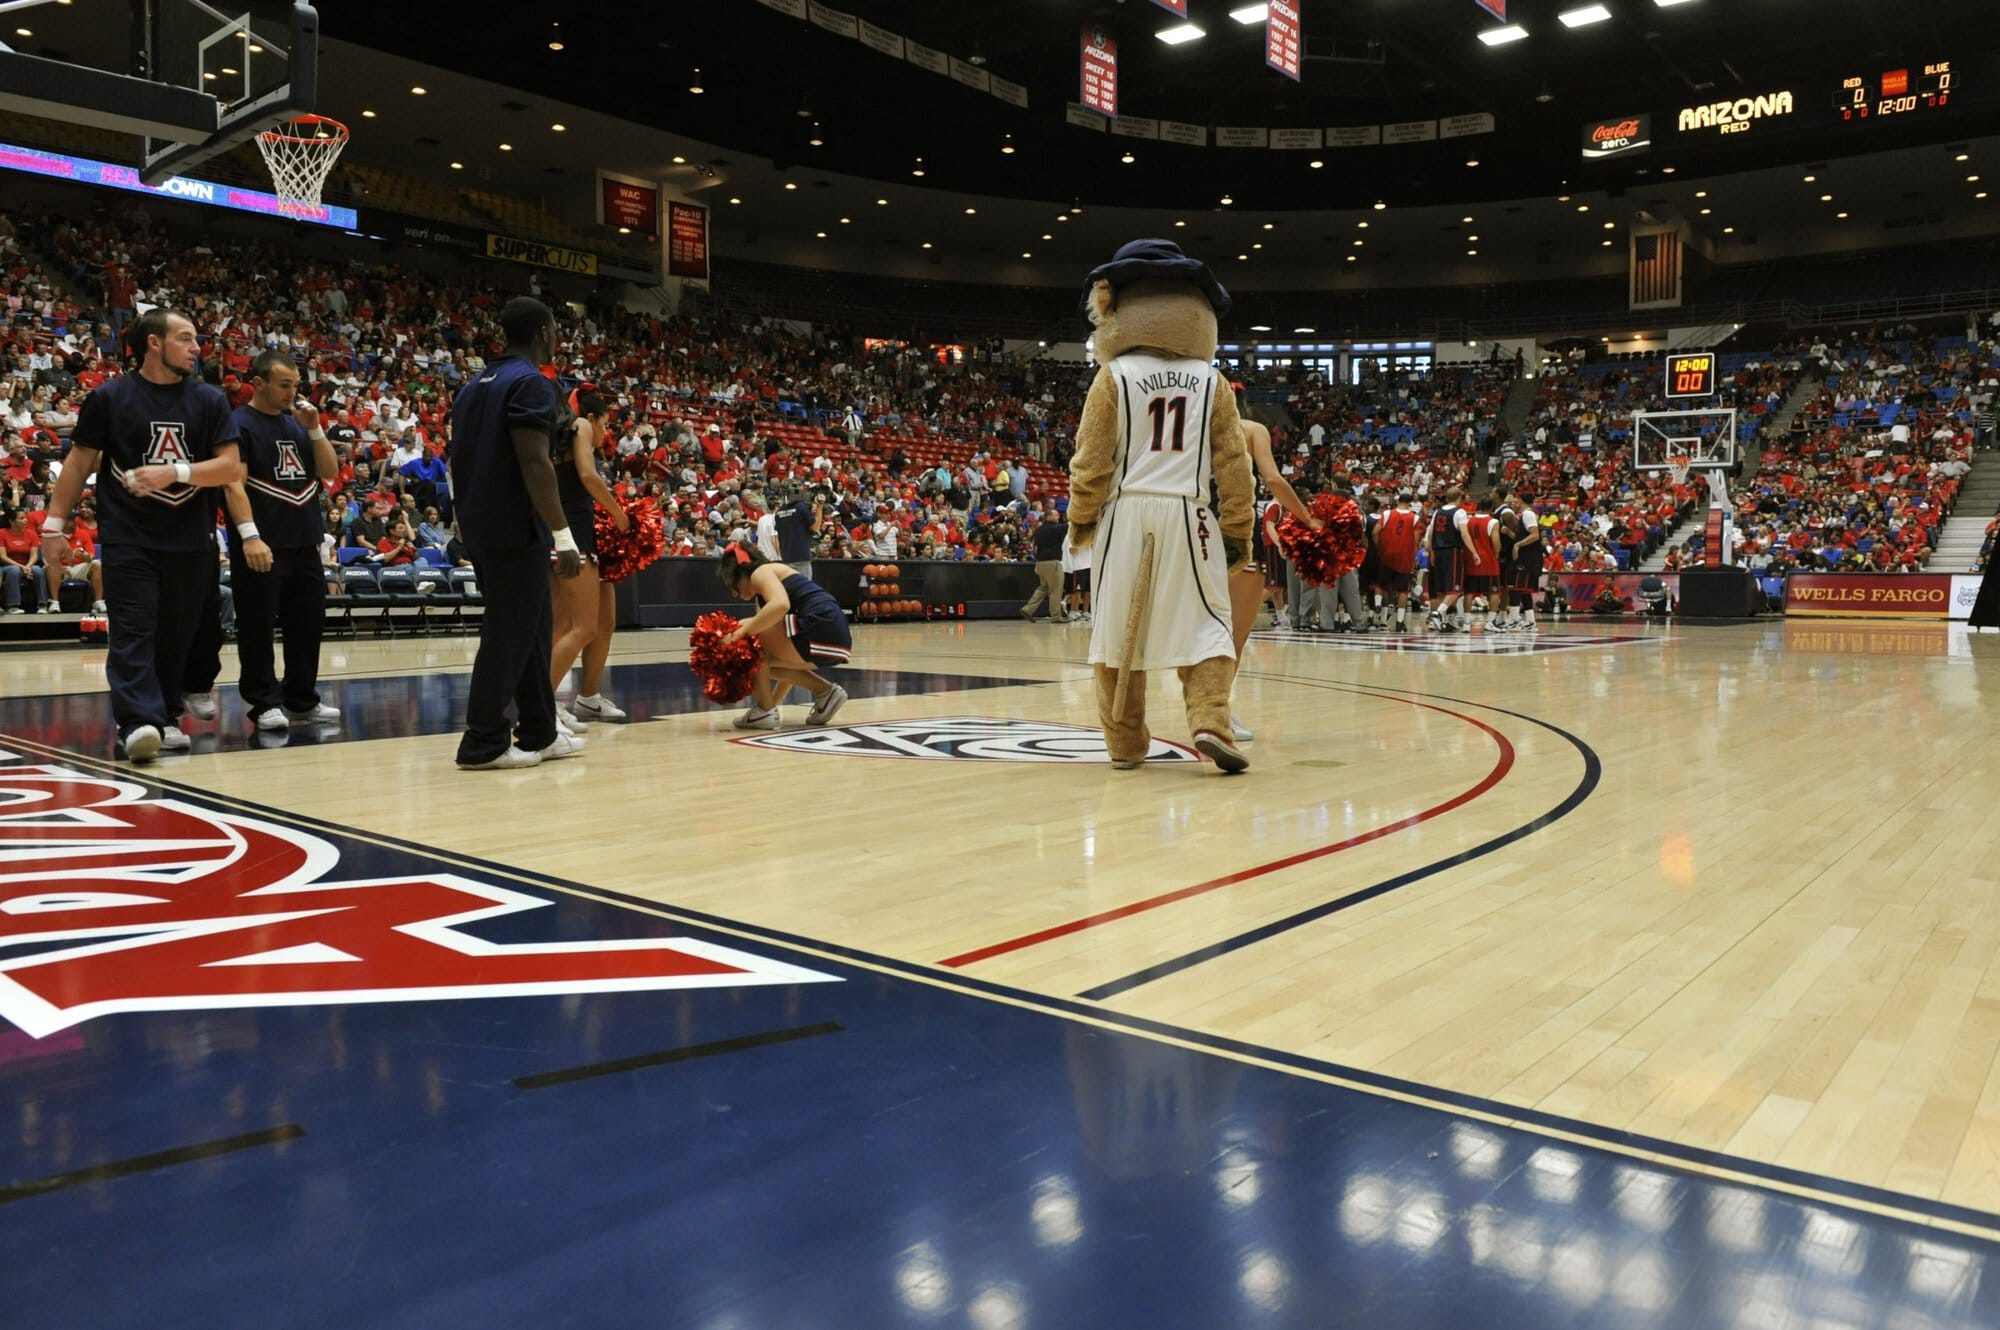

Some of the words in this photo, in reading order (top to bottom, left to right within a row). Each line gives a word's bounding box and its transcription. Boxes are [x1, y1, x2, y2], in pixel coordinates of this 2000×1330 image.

[1085, 45, 1115, 64] ARIZONA
[1924, 61, 1950, 75] BLUE
[1843, 76, 1862, 89] RED
[1939, 73, 1950, 89] 0
[1853, 88, 1865, 103] 0
[1878, 95, 1917, 115] 12:00
[1678, 90, 1793, 132] ARIZONA
[1592, 119, 1641, 143] Coca-Cola
[1720, 120, 1751, 135] RED
[620, 188, 641, 201] WAC
[492, 236, 590, 272] SUPERCUTS
[1675, 358, 1709, 373] 12:00
[1136, 371, 1200, 395] WILBUR
[1676, 373, 1703, 391] 00
[1147, 396, 1187, 452] 11
[142, 421, 194, 466] A
[274, 440, 307, 480] A
[1195, 506, 1210, 561] CATS
[1792, 587, 1866, 602] WELLS
[1871, 588, 1945, 602] FARGO
